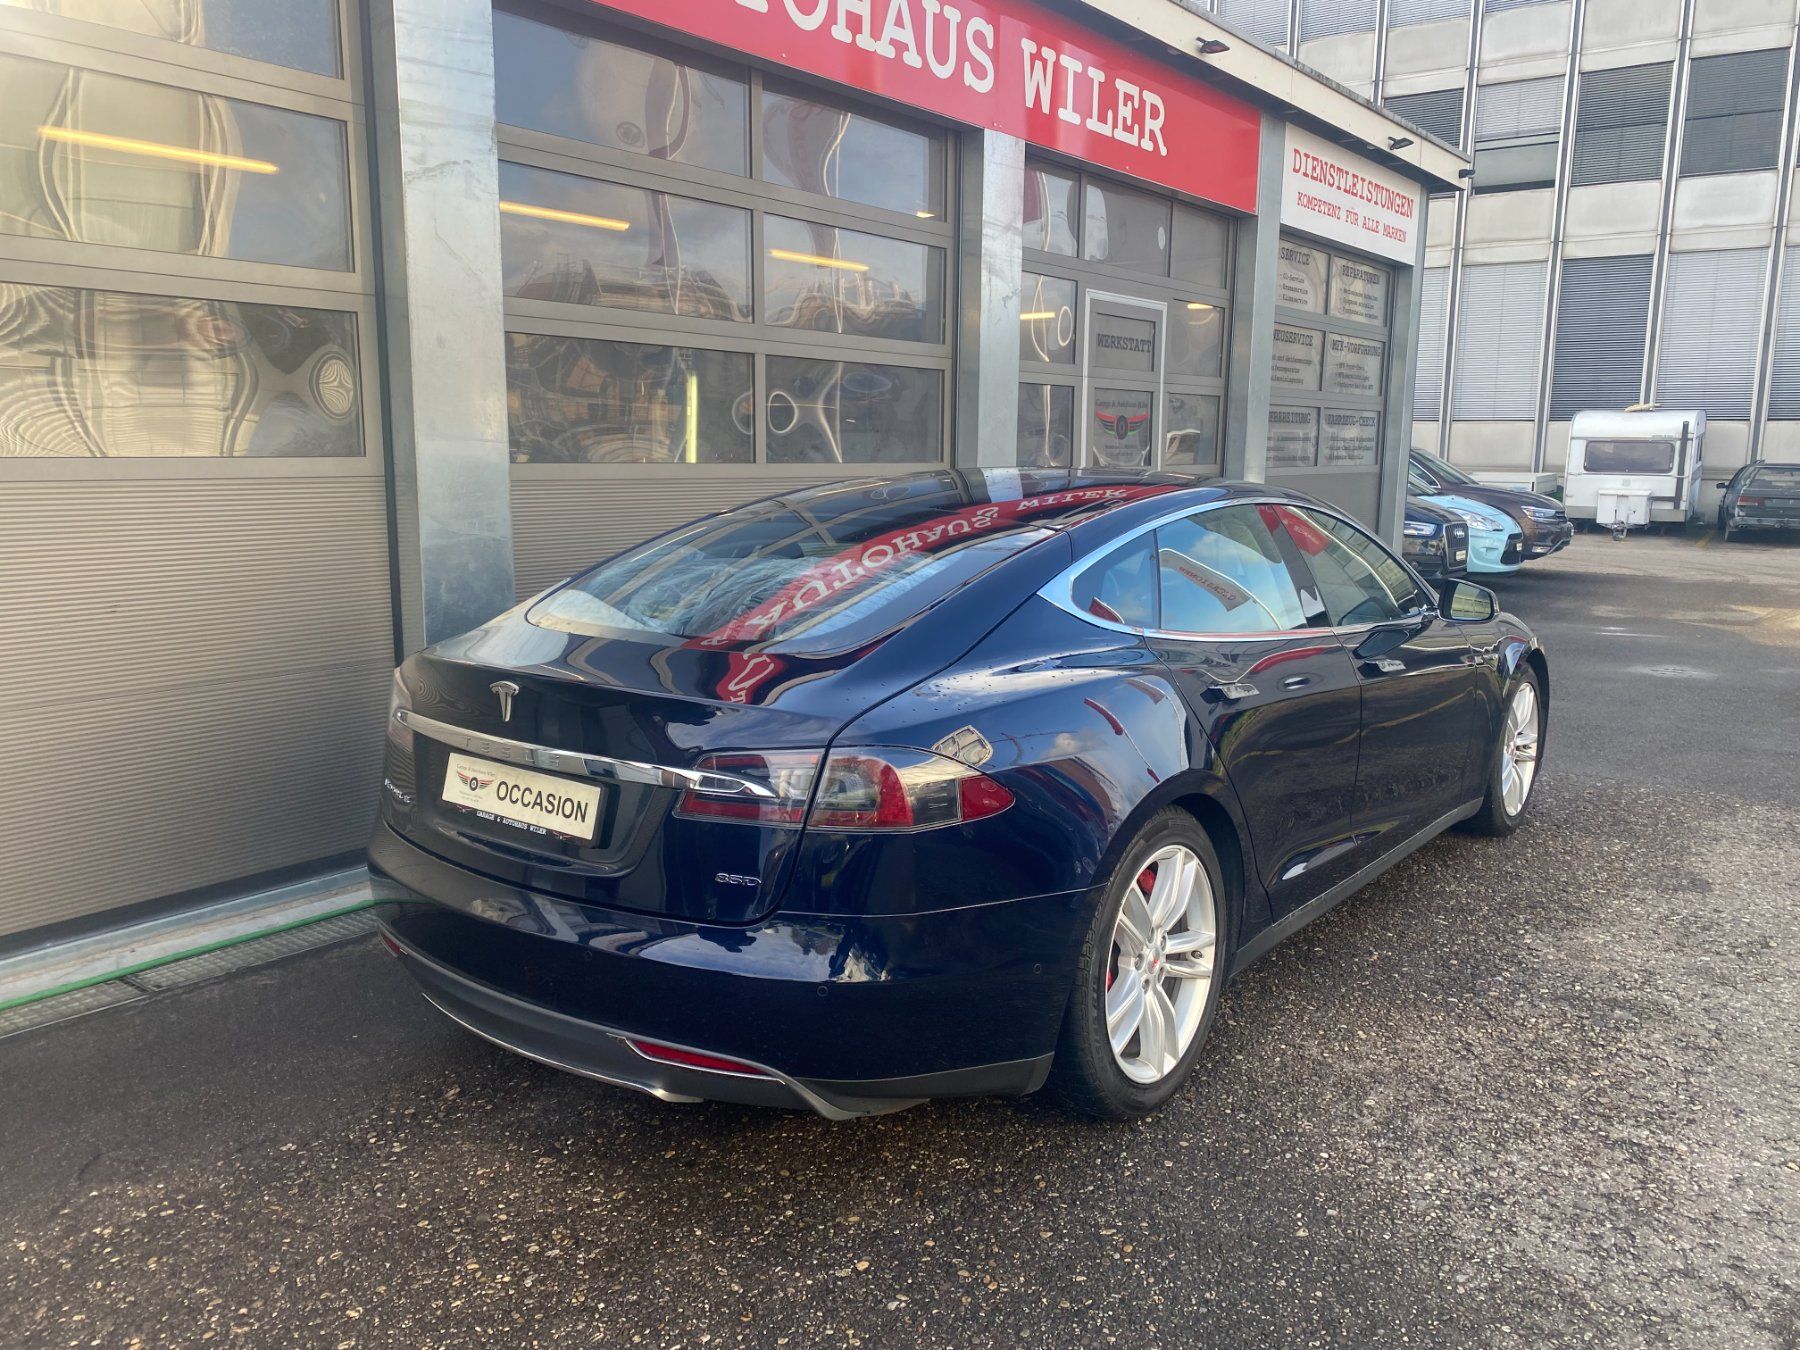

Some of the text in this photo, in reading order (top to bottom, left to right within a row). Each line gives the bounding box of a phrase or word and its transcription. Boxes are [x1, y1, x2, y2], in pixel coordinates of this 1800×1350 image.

[734, 0, 1168, 156] HAUS WILER
[1292, 148, 1414, 220] DIENSTLEISTUNGEN
[1297, 191, 1341, 221] KOMPETENZ
[1362, 215, 1379, 234] ALLE
[1383, 223, 1407, 243] MARKEN
[1280, 247, 1311, 266] SERVICE
[1097, 333, 1152, 353] WERKSTATT
[496, 780, 589, 823] OCCASION
[503, 818, 528, 830] AUTOHAUS
